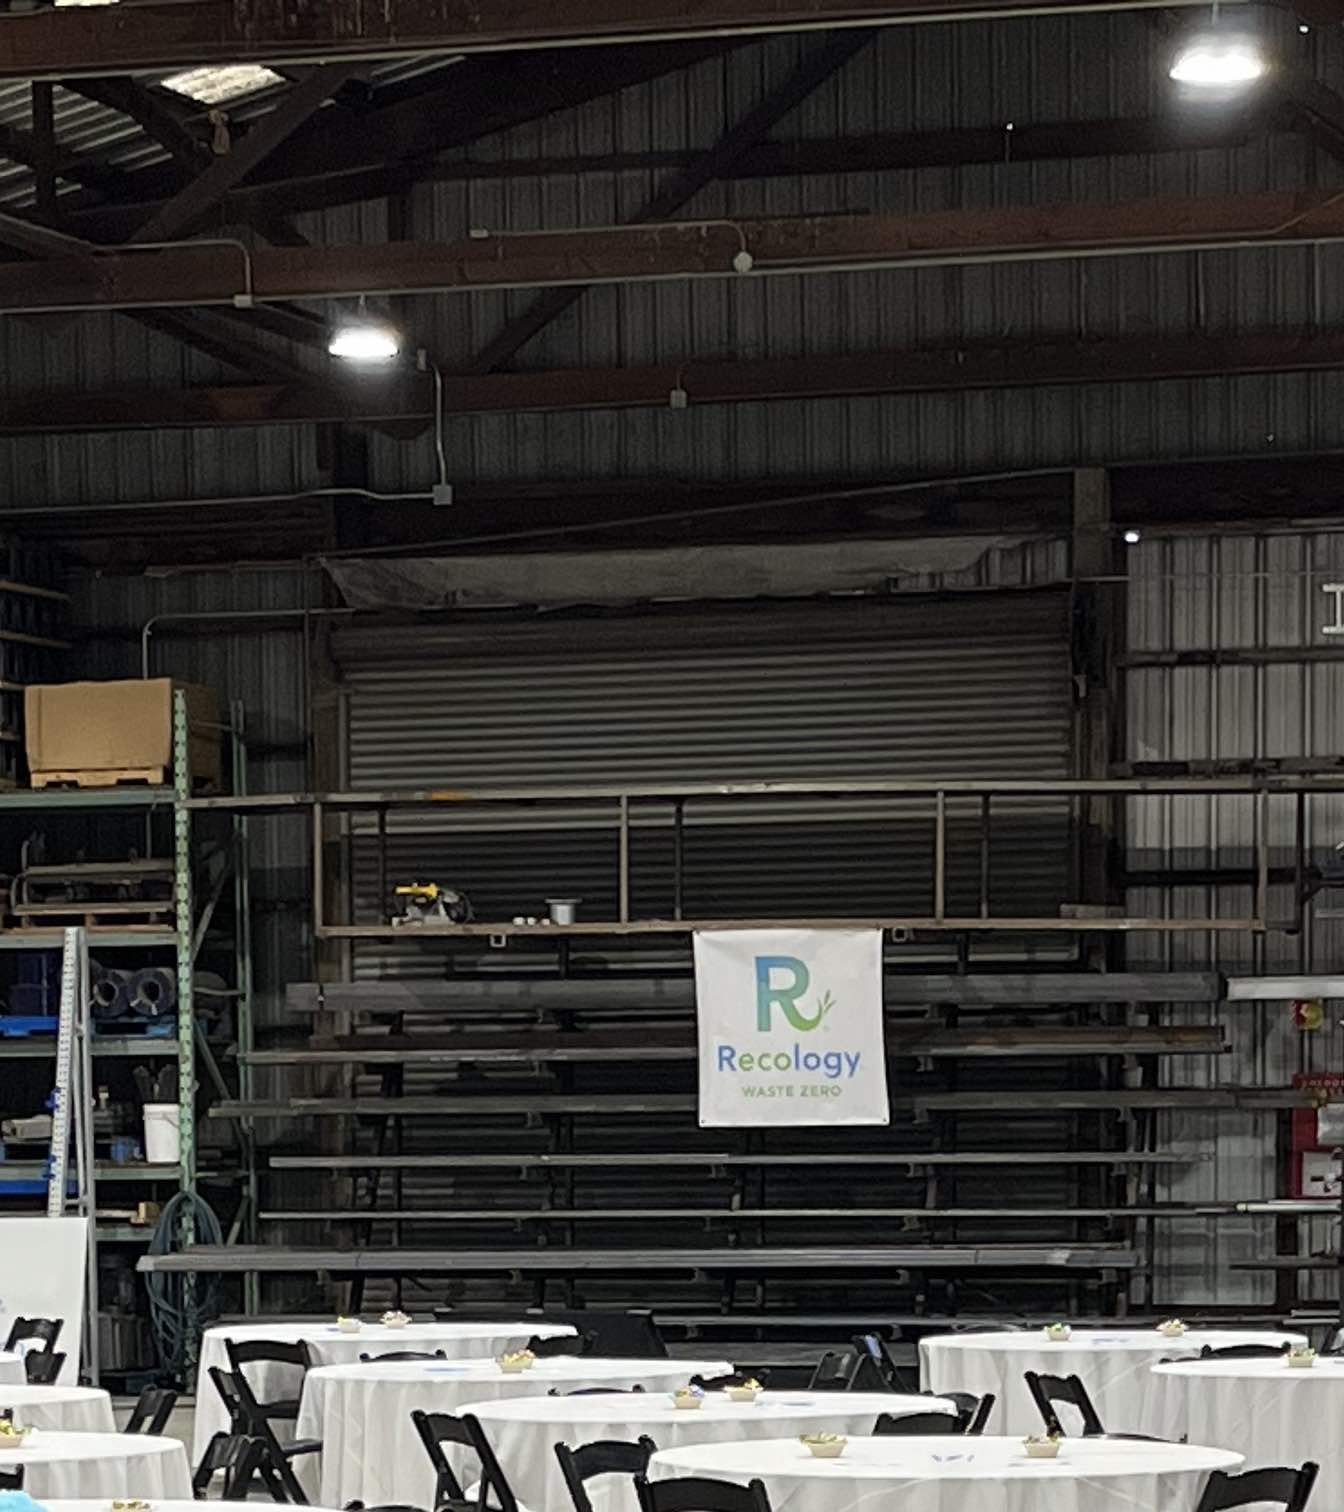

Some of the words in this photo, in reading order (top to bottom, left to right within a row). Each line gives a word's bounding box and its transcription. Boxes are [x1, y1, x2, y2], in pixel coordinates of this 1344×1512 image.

[717, 1044, 860, 1079] Recology
[741, 1084, 794, 1098] WASTE
[799, 1084, 843, 1098] ZERO
